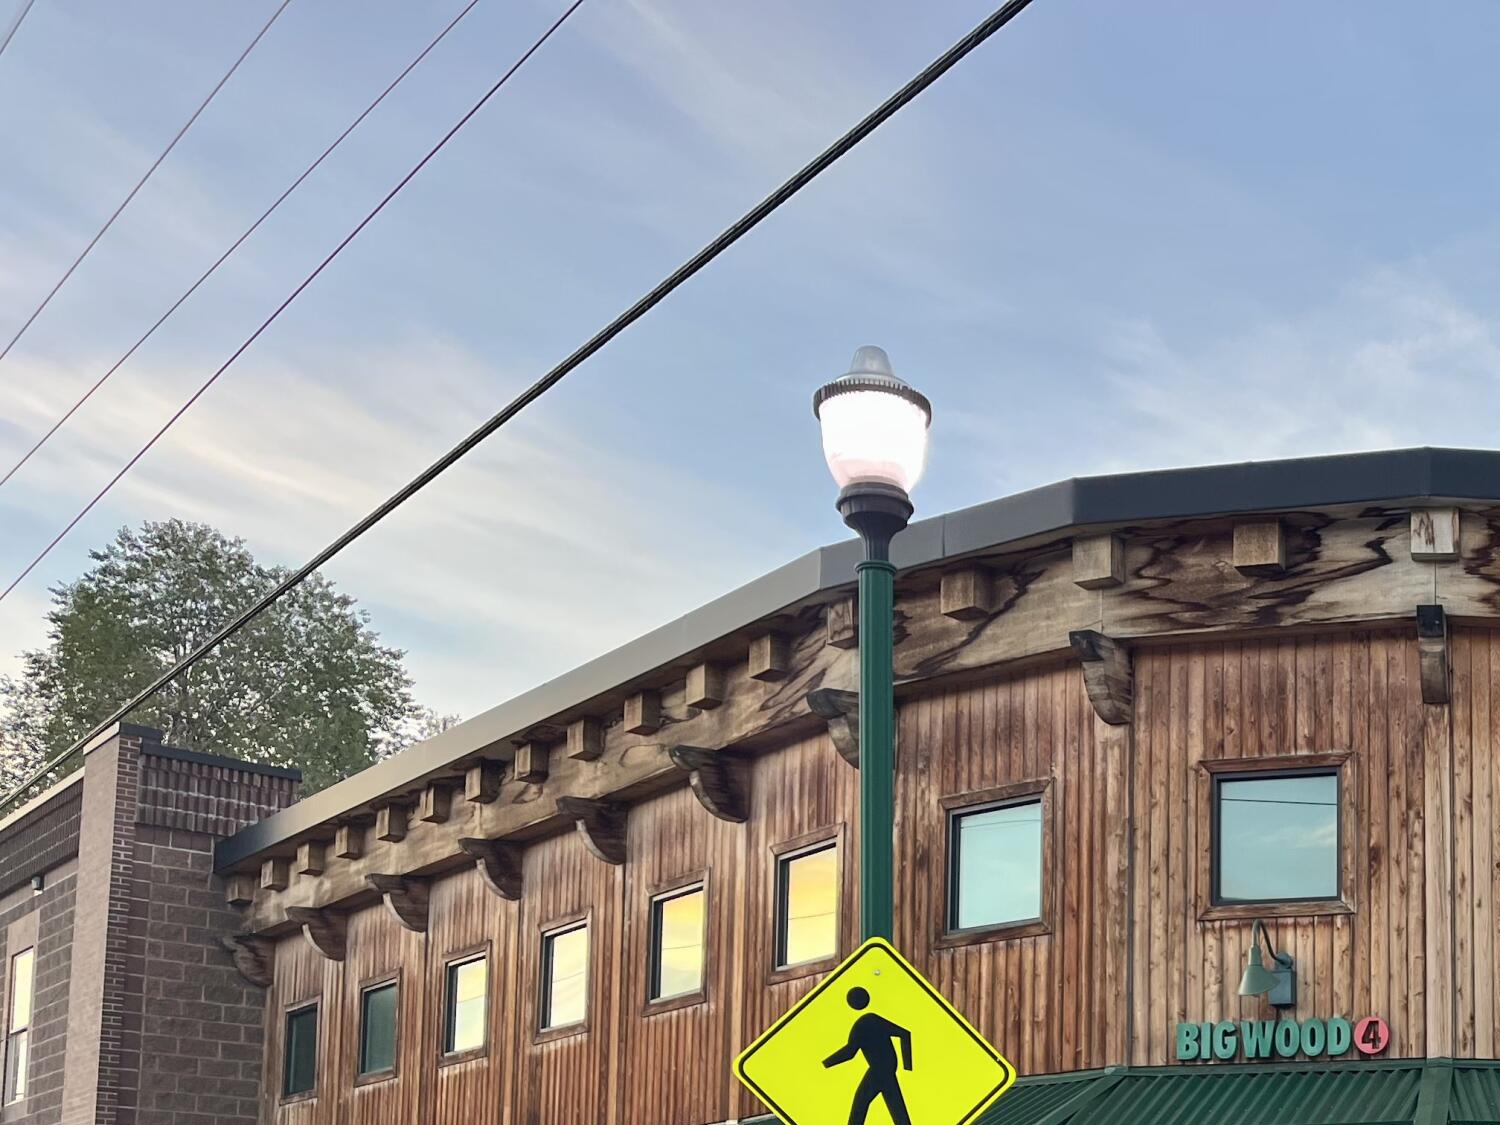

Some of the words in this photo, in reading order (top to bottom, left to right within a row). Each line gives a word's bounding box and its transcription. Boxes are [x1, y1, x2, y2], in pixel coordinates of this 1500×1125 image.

[1177, 1021, 1238, 1060] BIG
[1241, 1017, 1351, 1058] WOOD
[1361, 1020, 1381, 1049] 4
